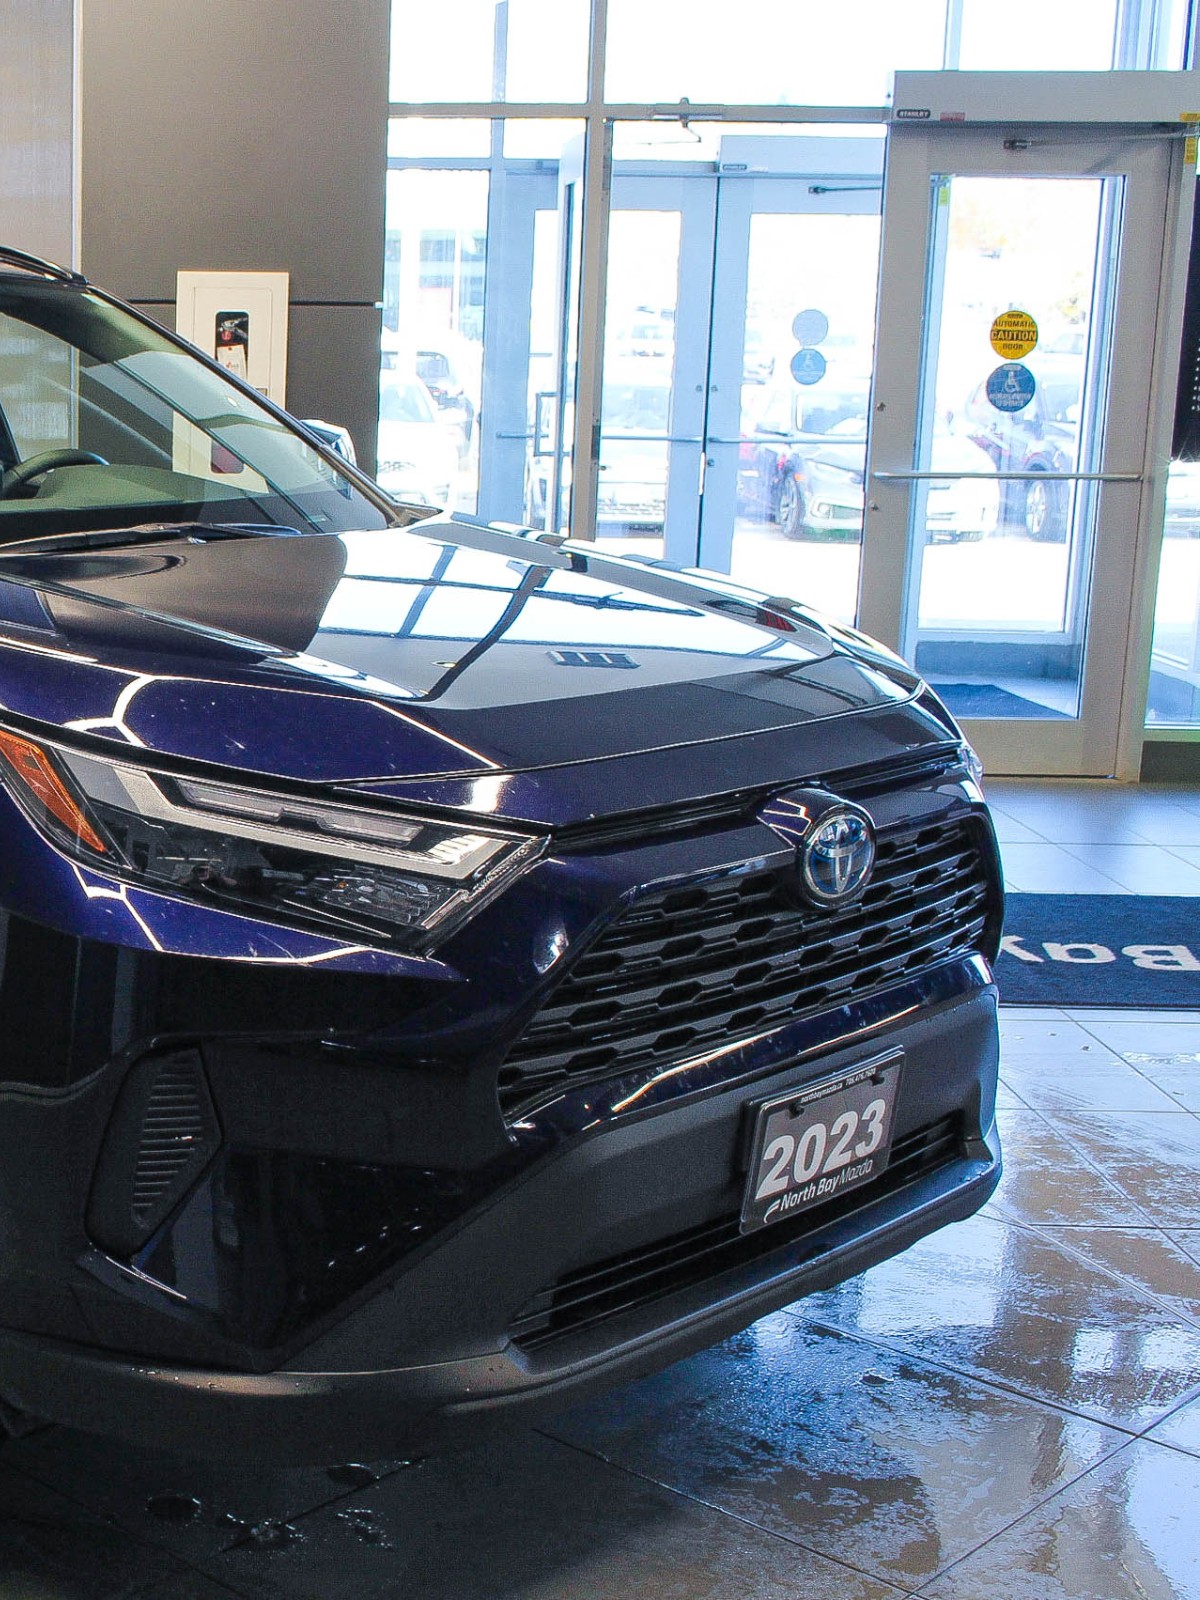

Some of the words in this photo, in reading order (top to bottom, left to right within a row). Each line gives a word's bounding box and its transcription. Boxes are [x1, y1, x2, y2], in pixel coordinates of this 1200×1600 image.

[898, 110, 929, 118] STANLEY
[992, 320, 1035, 328] AUTOMATIC
[990, 330, 1037, 341] CAUTION
[1002, 343, 1023, 351] DOOR
[1000, 934, 1200, 971] Bay
[755, 1099, 886, 1199] 2023
[780, 1182, 817, 1212] North
[816, 1175, 840, 1196] Bay
[838, 1158, 874, 1186] Mazda
